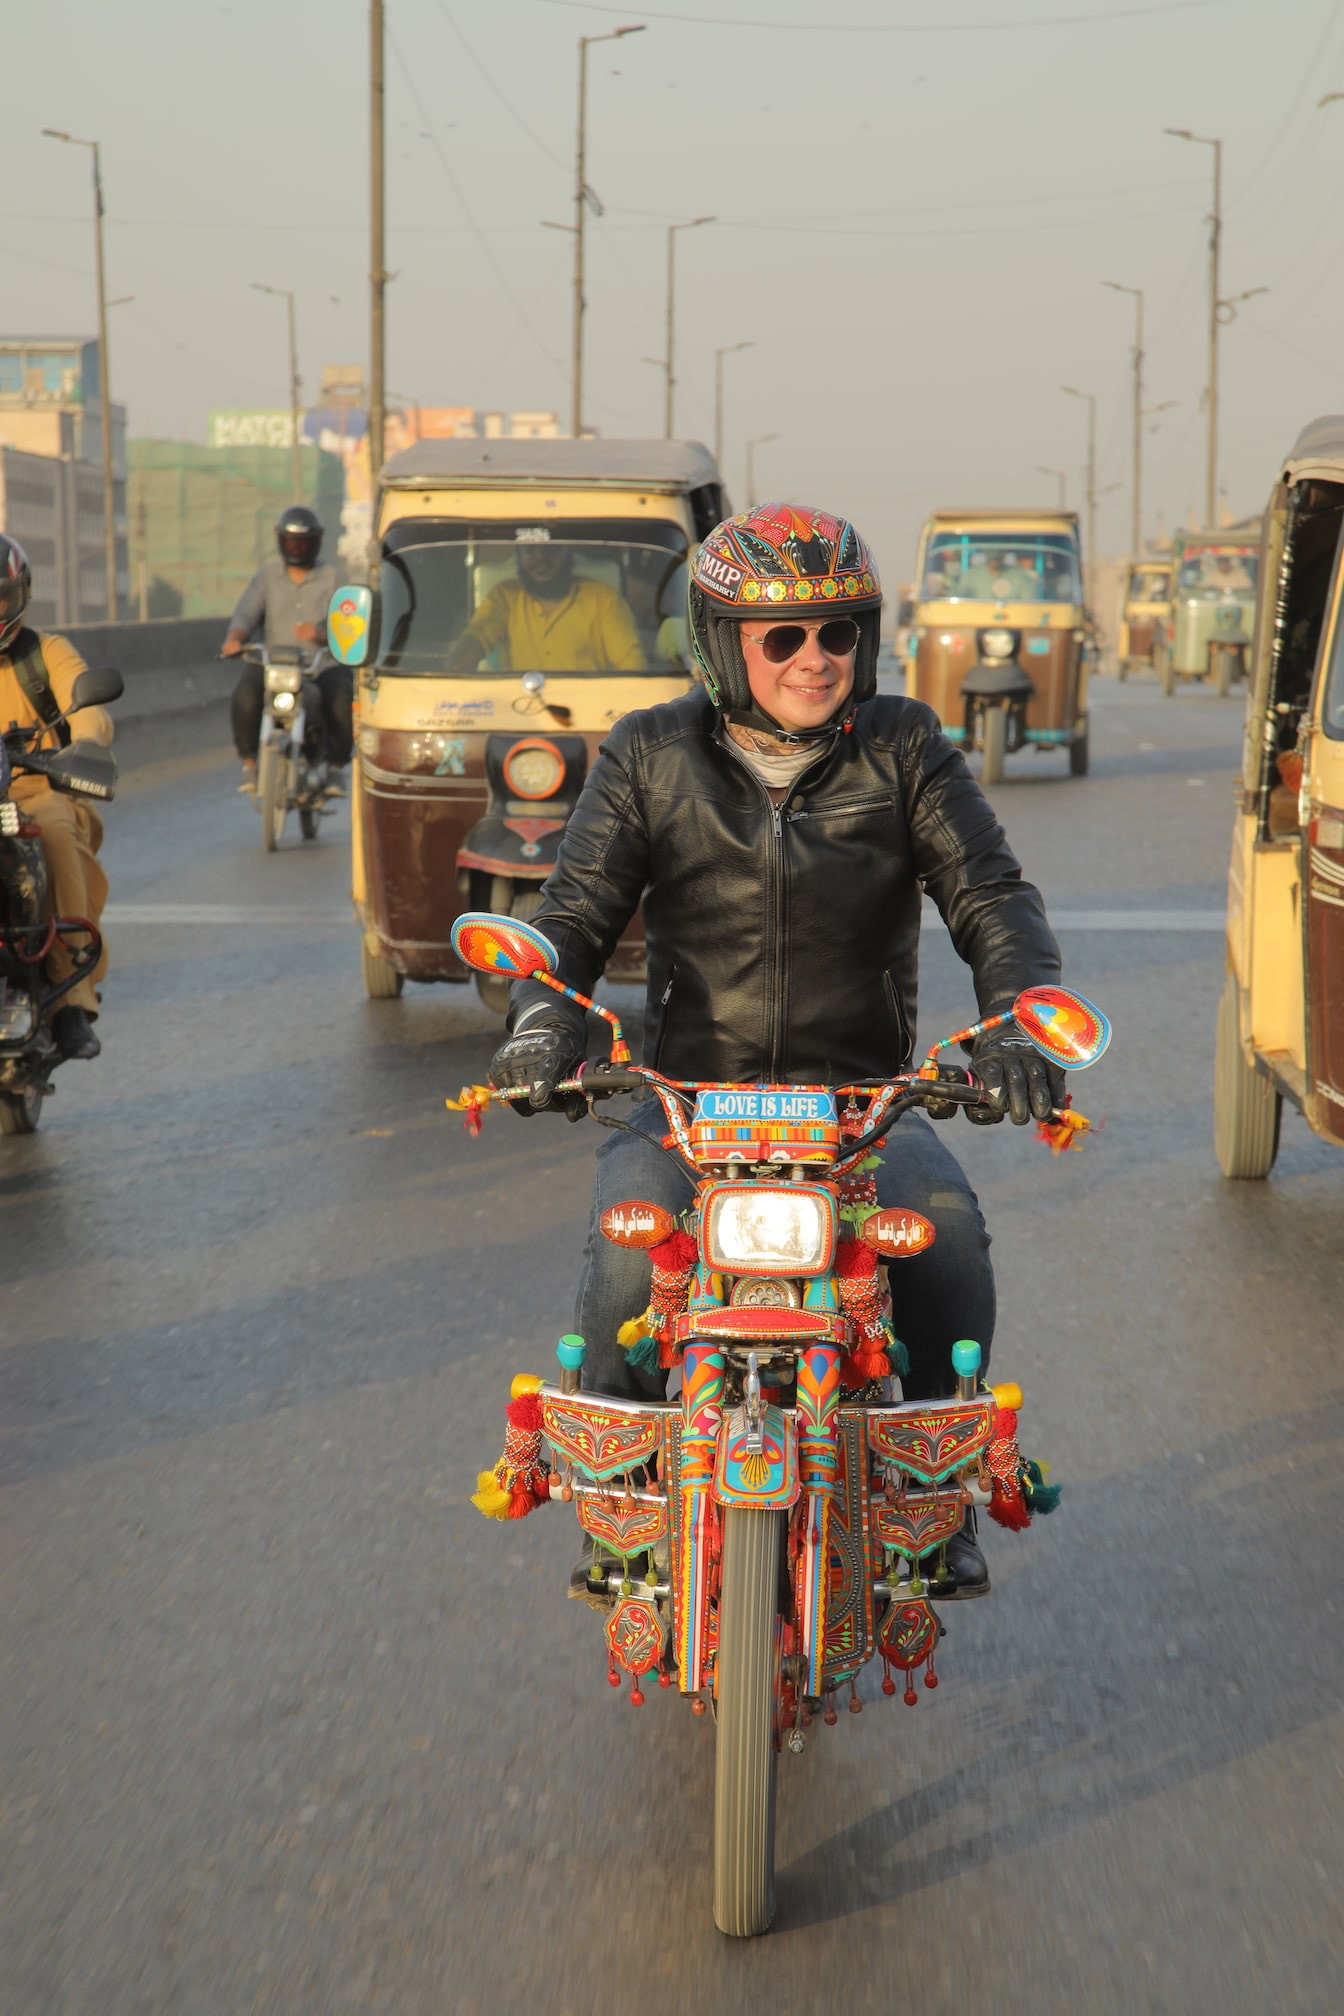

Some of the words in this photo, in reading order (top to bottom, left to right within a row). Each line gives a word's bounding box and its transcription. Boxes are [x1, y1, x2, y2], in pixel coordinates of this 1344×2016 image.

[702, 554, 741, 585] МИР
[70, 777, 107, 797] YAMAHA
[714, 1095, 757, 1116] LOVE
[761, 1097, 777, 1116] IS
[780, 1097, 818, 1118] LIFE
